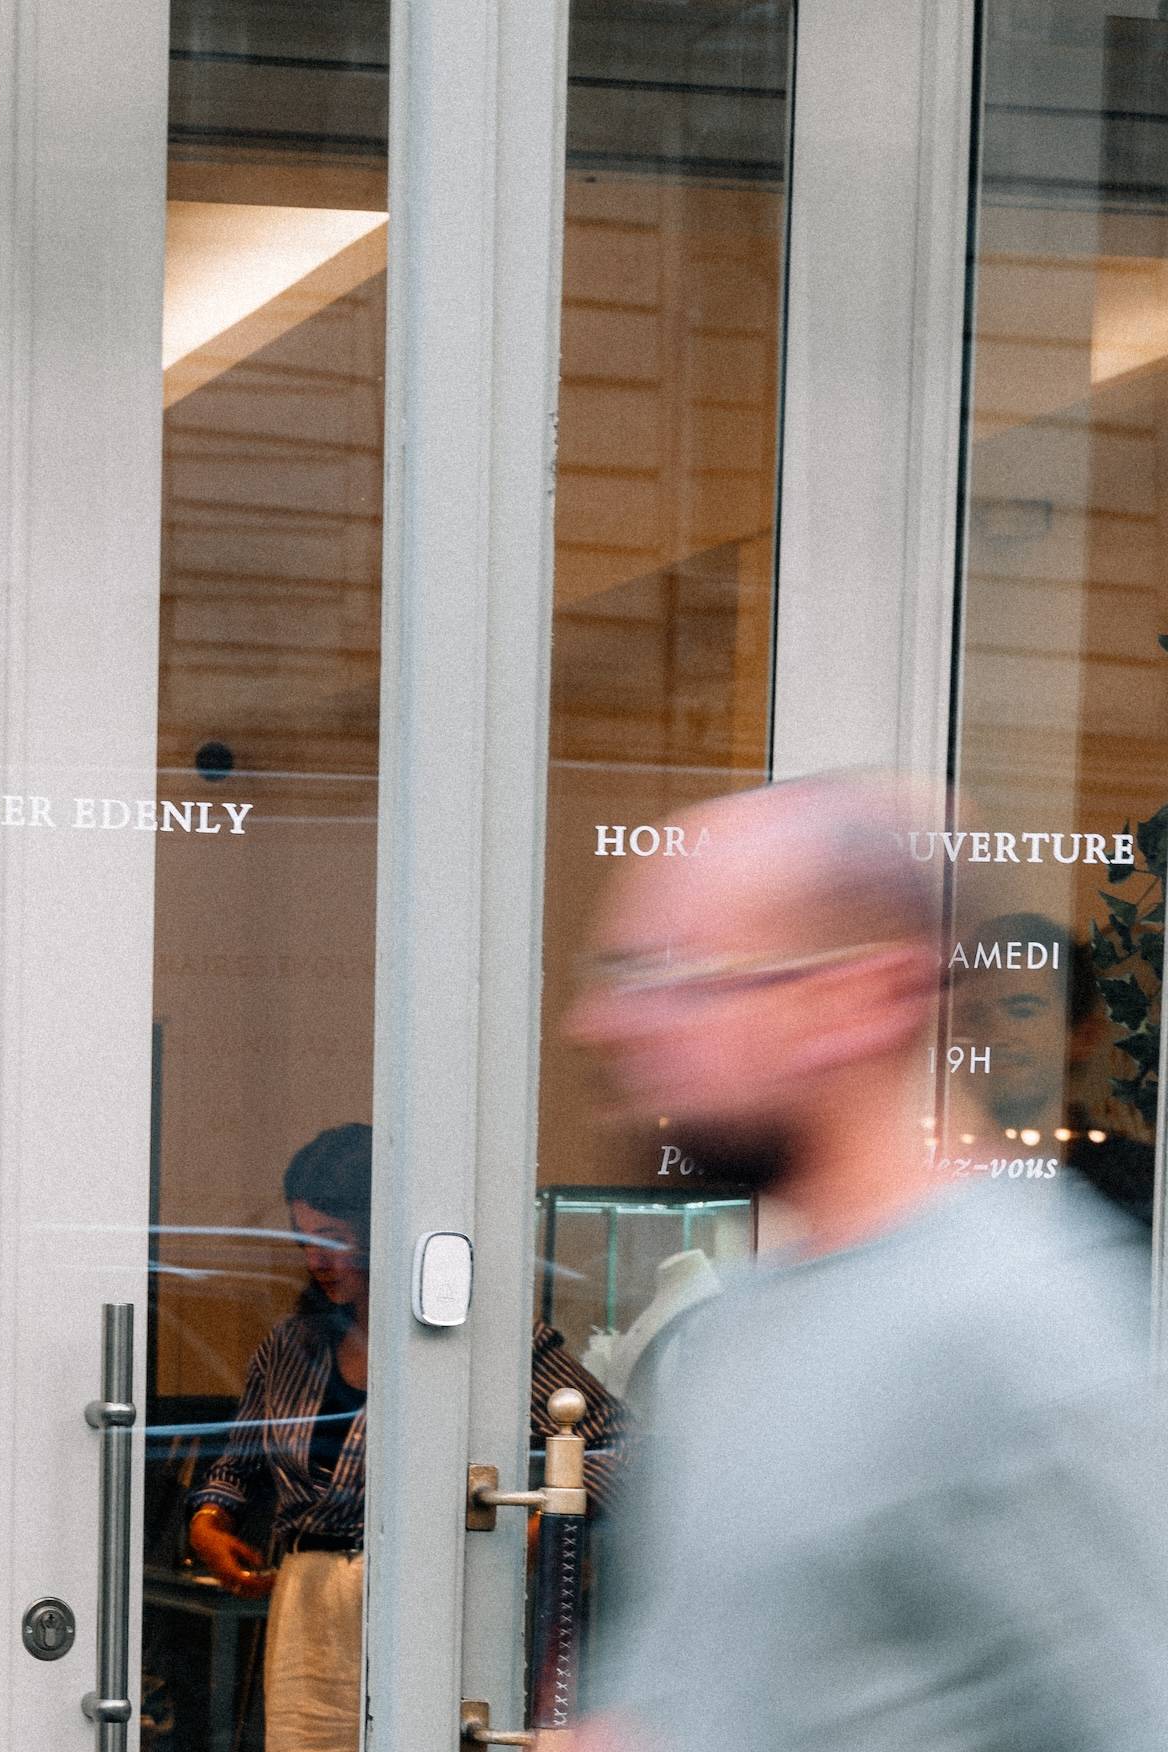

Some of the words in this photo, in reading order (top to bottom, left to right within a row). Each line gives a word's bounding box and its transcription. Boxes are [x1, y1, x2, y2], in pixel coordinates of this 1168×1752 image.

[71, 798, 254, 834] EDENLY
[594, 825, 712, 857] HORA
[907, 831, 1135, 865] UVERTURE
[938, 941, 1060, 970] AMEDI
[928, 1046, 991, 1074] 19H
